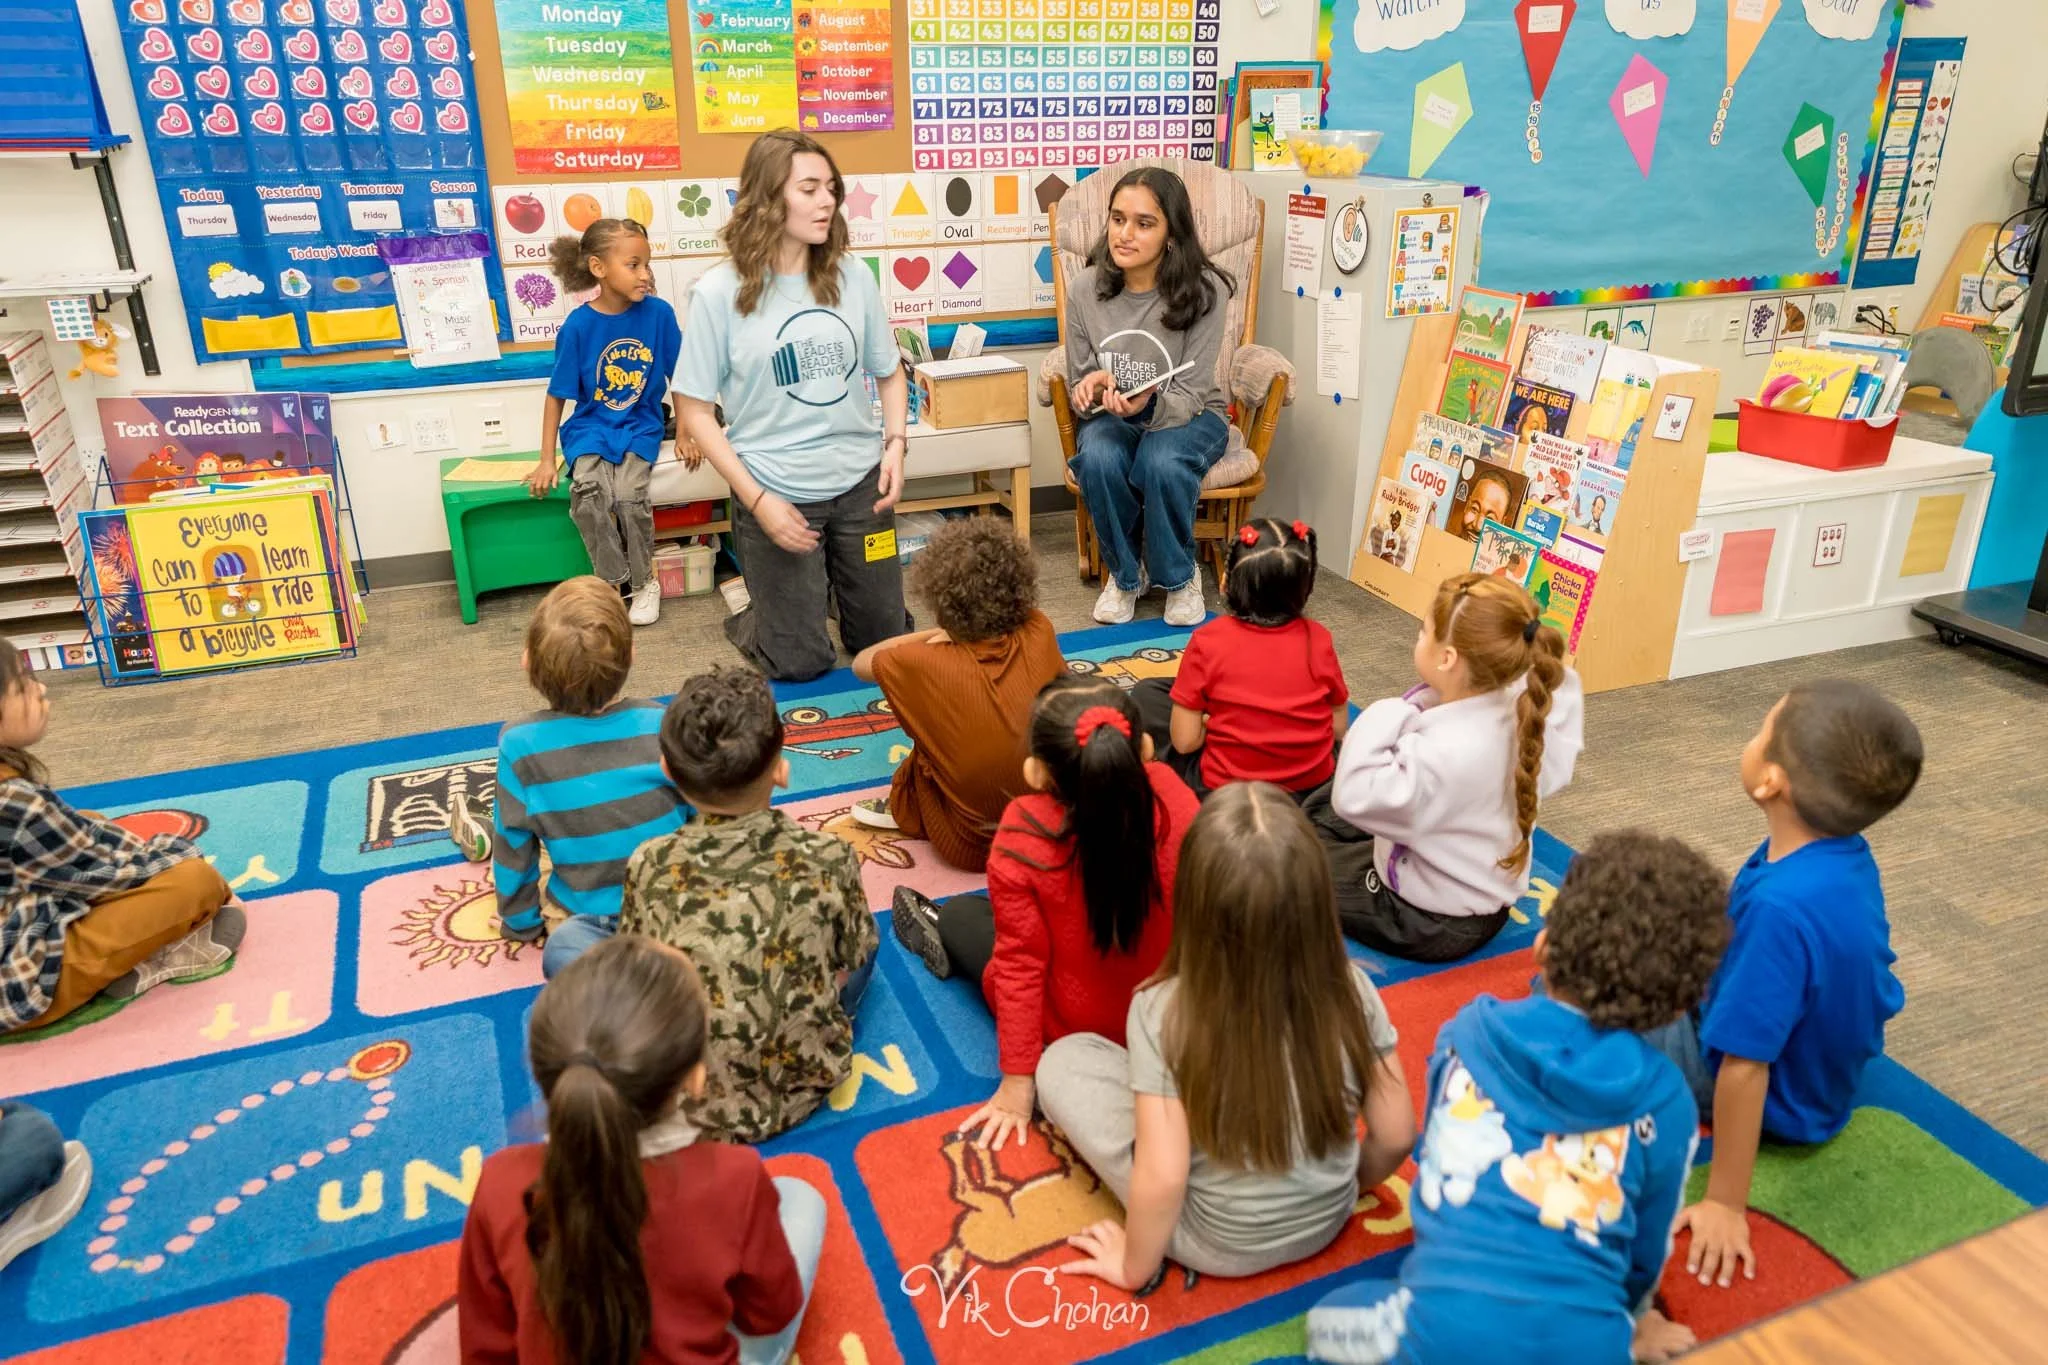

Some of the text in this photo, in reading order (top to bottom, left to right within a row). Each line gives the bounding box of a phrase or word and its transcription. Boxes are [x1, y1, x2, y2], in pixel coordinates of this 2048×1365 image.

[541, 5, 623, 27] Monday
[720, 13, 791, 31] February
[818, 13, 865, 28] August
[545, 37, 628, 58] Tuesday
[722, 39, 773, 53] March
[820, 40, 889, 55] September
[532, 66, 646, 86] Wednesday
[726, 64, 763, 81] April
[822, 65, 873, 78] October
[916, 75, 1215, 92] 61 62 63 64 65 66 67 68 69 70
[727, 91, 759, 108] May
[823, 89, 888, 101] November
[545, 94, 639, 114] Thursday
[917, 99, 1214, 117] 71 72 73 74 75 76 77 78 79 80
[730, 114, 765, 127] June
[823, 112, 887, 124] December
[565, 123, 626, 143] Friday
[918, 122, 1212, 143] 81 82 83 84 85 86 87 88 89 90
[554, 151, 644, 170] Saturday
[918, 147, 1212, 168] 91 92 93 94 95 96 97 100
[257, 184, 321, 199] Yesterday
[341, 183, 404, 196] Tomorrow
[430, 181, 477, 193] Season
[180, 188, 224, 203] Today
[187, 217, 228, 225] Thursday
[268, 213, 317, 223] Wednesday
[363, 211, 388, 221] Friday
[849, 231, 875, 242] Star
[891, 228, 932, 241] Triangle
[944, 225, 974, 239] Oval
[987, 225, 1027, 235] Rectangle
[677, 237, 719, 250] Green
[288, 243, 378, 260] Today's Weath
[514, 244, 547, 259] Red
[432, 276, 470, 288] Spanish
[894, 299, 934, 314] Heart
[941, 298, 982, 309] Diamond
[444, 315, 472, 325] Music
[794, 338, 813, 349] THE
[799, 352, 844, 372] READES
[1113, 352, 1131, 361] THE
[801, 363, 849, 381] NETWOK
[1114, 361, 1157, 372] LEADERS
[1114, 370, 1158, 381] READERS
[1515, 385, 1571, 410] WE ARE HERE
[174, 406, 232, 419] ReadyGEN
[282, 402, 295, 418] K
[312, 406, 325, 421] K
[113, 418, 262, 438] Text Collection
[1535, 444, 1574, 462] OLD LADY WHO
[1410, 463, 1447, 497] Cupig
[1381, 490, 1421, 514] Ruby Bridges
[179, 511, 268, 548] Everyone
[261, 542, 310, 575] learn
[153, 558, 196, 587] Can
[1553, 571, 1582, 591] Chicka
[272, 577, 314, 607] ride
[1551, 581, 1579, 600] Chicka
[174, 588, 203, 617] to
[179, 619, 276, 658] a bicycle
[123, 647, 153, 658] Happy
